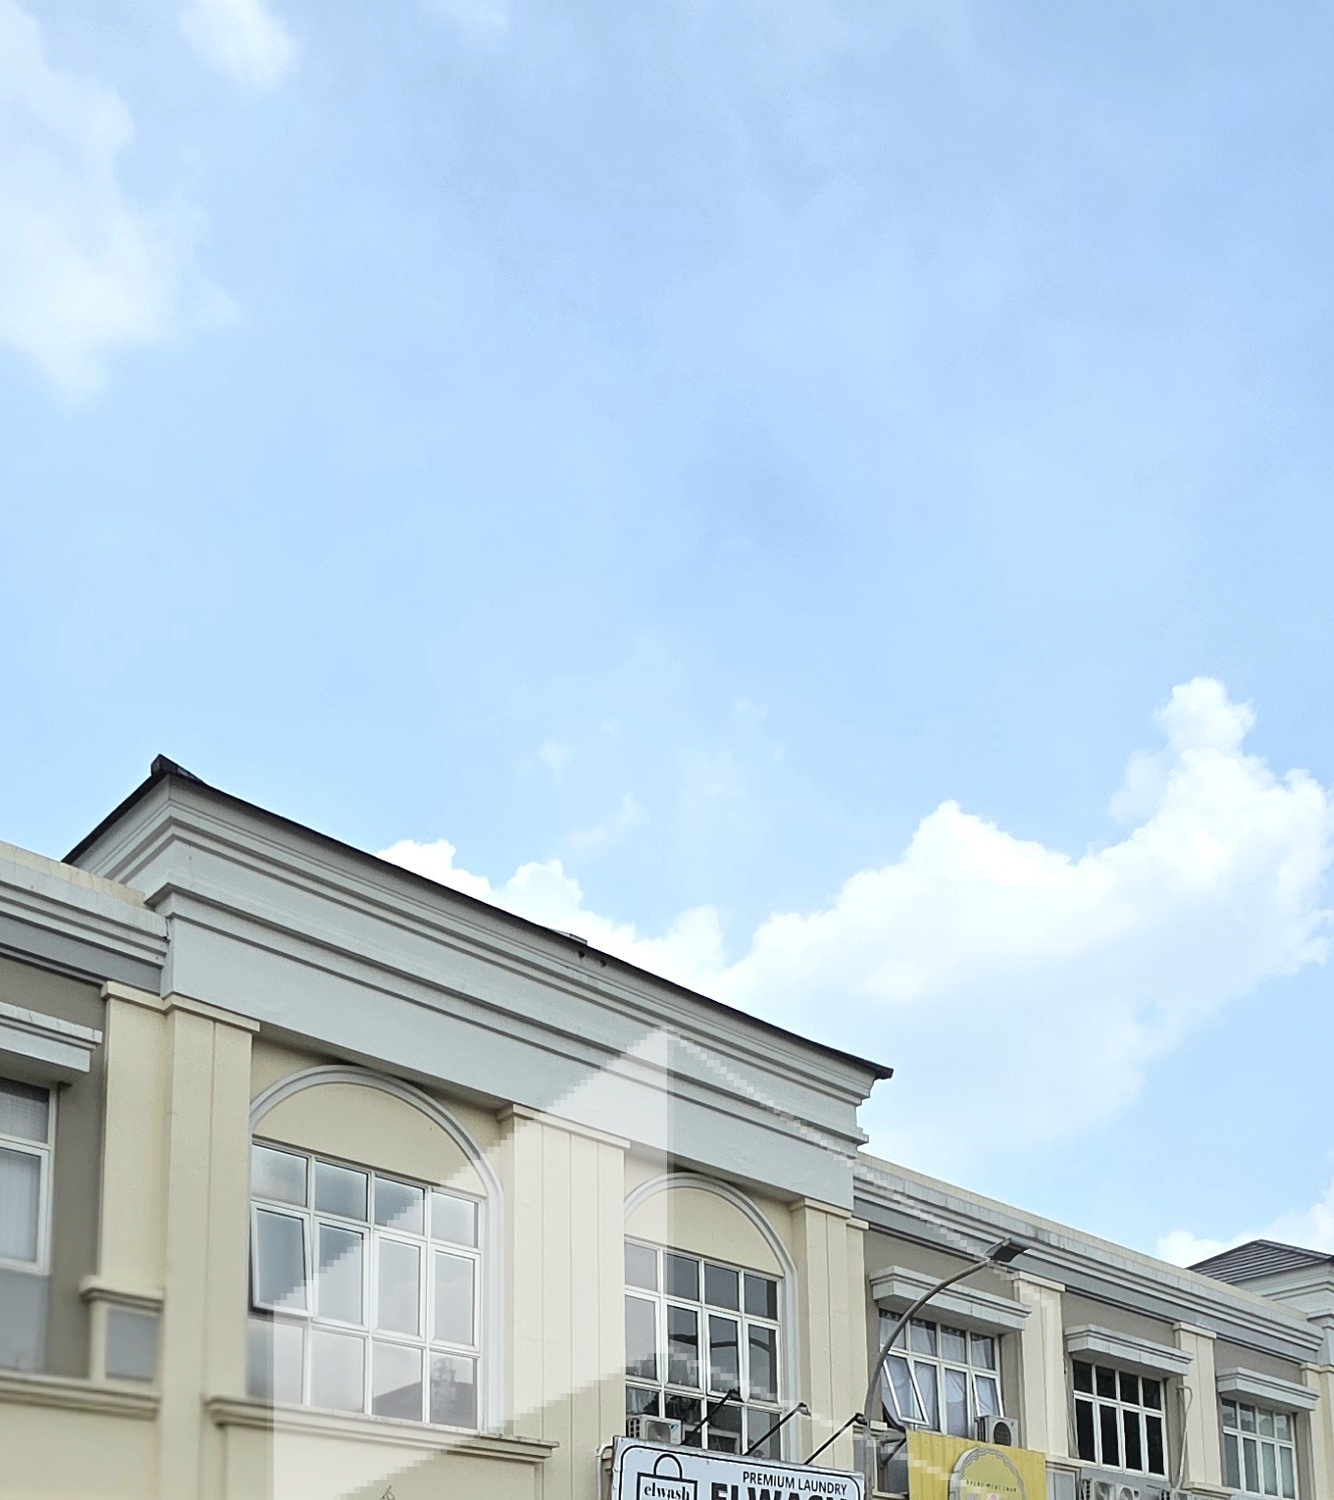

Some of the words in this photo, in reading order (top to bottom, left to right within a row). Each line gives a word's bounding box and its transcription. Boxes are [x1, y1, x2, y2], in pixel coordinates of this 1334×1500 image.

[643, 1482, 690, 1500] elwash
[742, 1471, 795, 1489] PREMIUM
[798, 1478, 847, 1496] LAUNDRY
